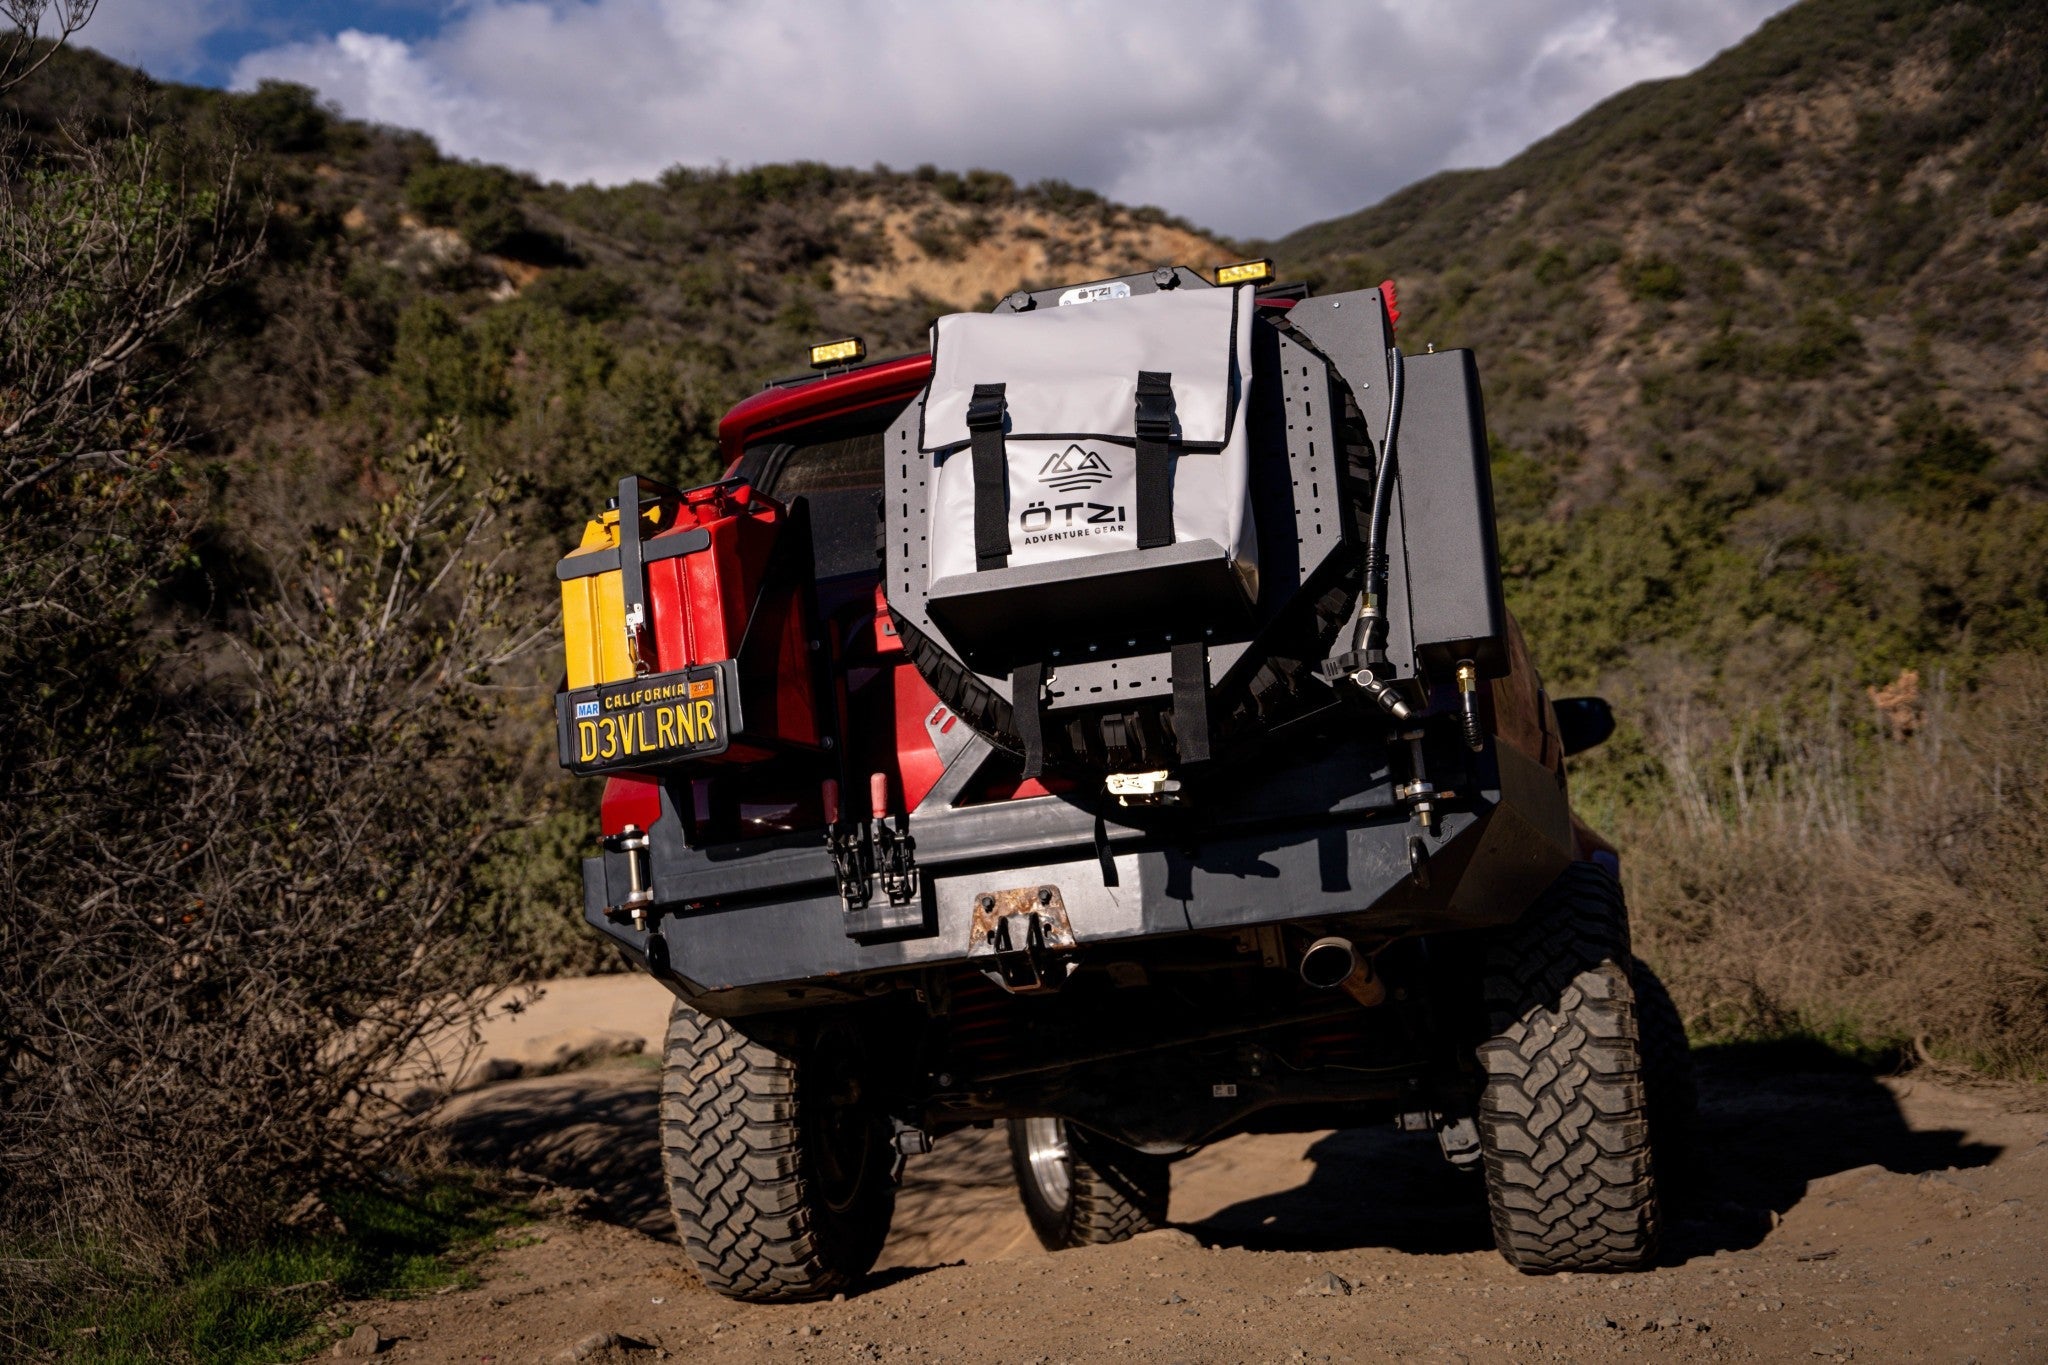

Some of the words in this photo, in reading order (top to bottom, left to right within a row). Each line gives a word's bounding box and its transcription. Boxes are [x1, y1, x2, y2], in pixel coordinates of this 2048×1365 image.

[1078, 286, 1111, 299] ÖTZI
[1020, 501, 1126, 533] ÖTZI
[1024, 528, 1090, 545] ADVENTURE
[1094, 525, 1125, 535] GEAR
[605, 683, 686, 710] CALIFORNIA
[578, 703, 599, 717] MAR
[578, 700, 716, 763] D3VLRNR
